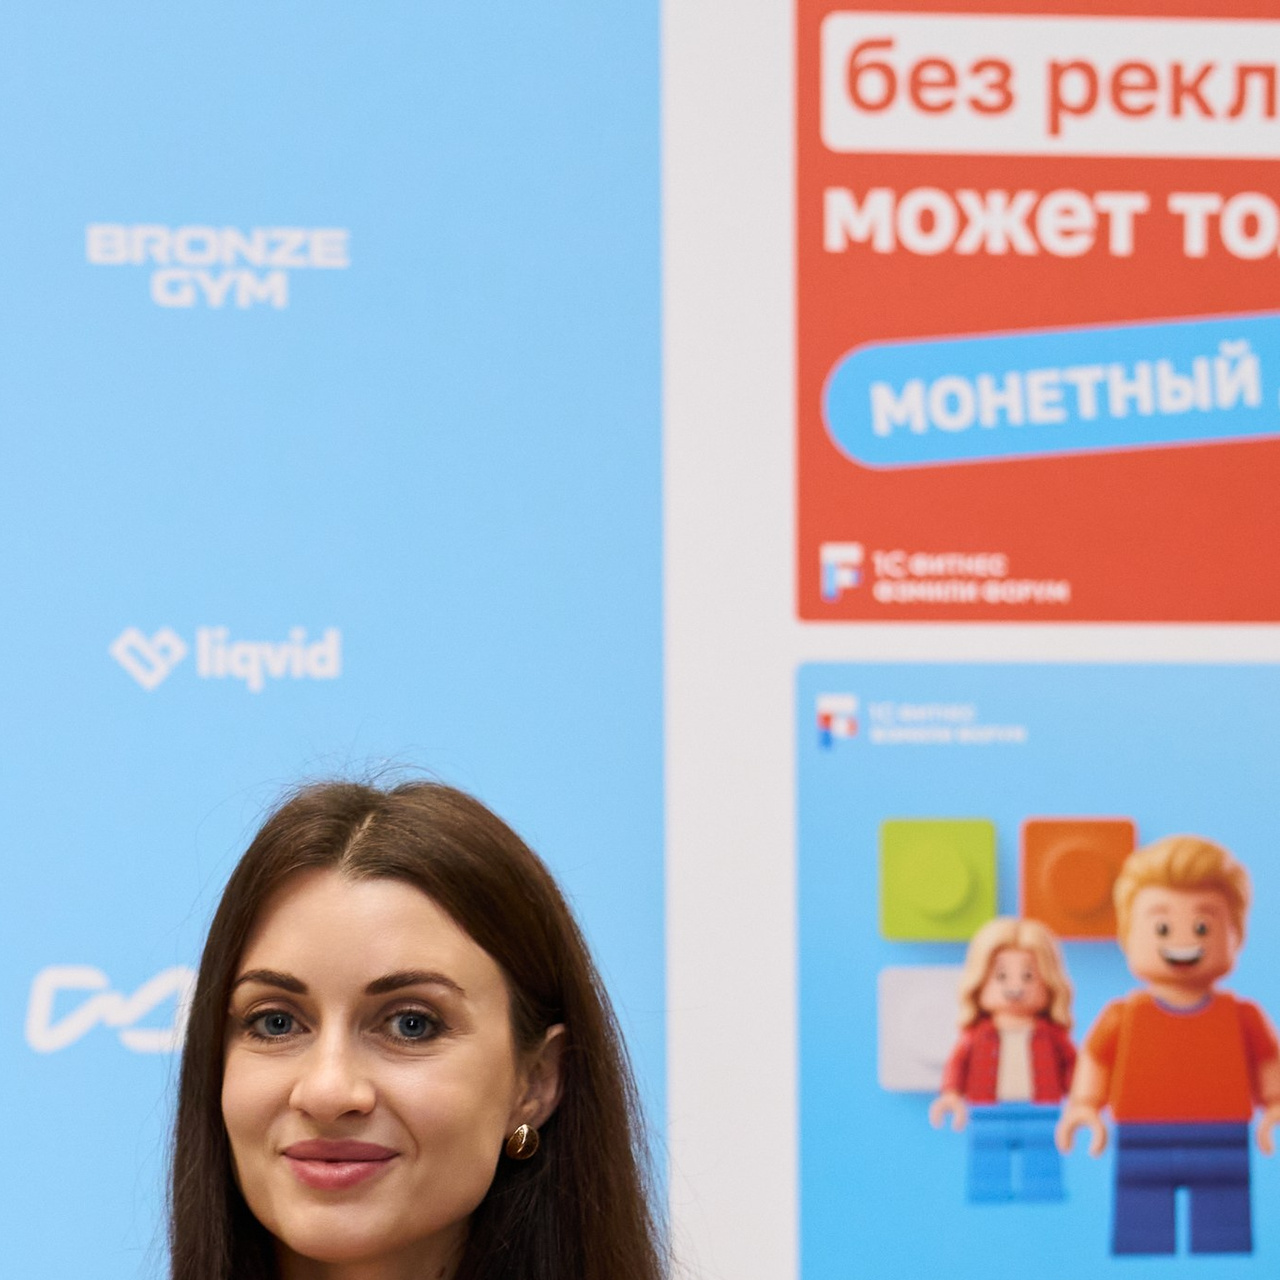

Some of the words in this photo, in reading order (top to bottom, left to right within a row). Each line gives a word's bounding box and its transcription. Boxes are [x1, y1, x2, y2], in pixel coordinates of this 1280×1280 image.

[845, 38, 1015, 117] без
[1046, 59, 1277, 137] рекл
[86, 224, 350, 267] BRONZE
[824, 187, 1150, 257] может
[1167, 191, 1280, 259] то
[150, 269, 288, 309] GYM
[870, 339, 1262, 436] МОНЕТНЫЙ
[196, 627, 342, 693] liqvid
